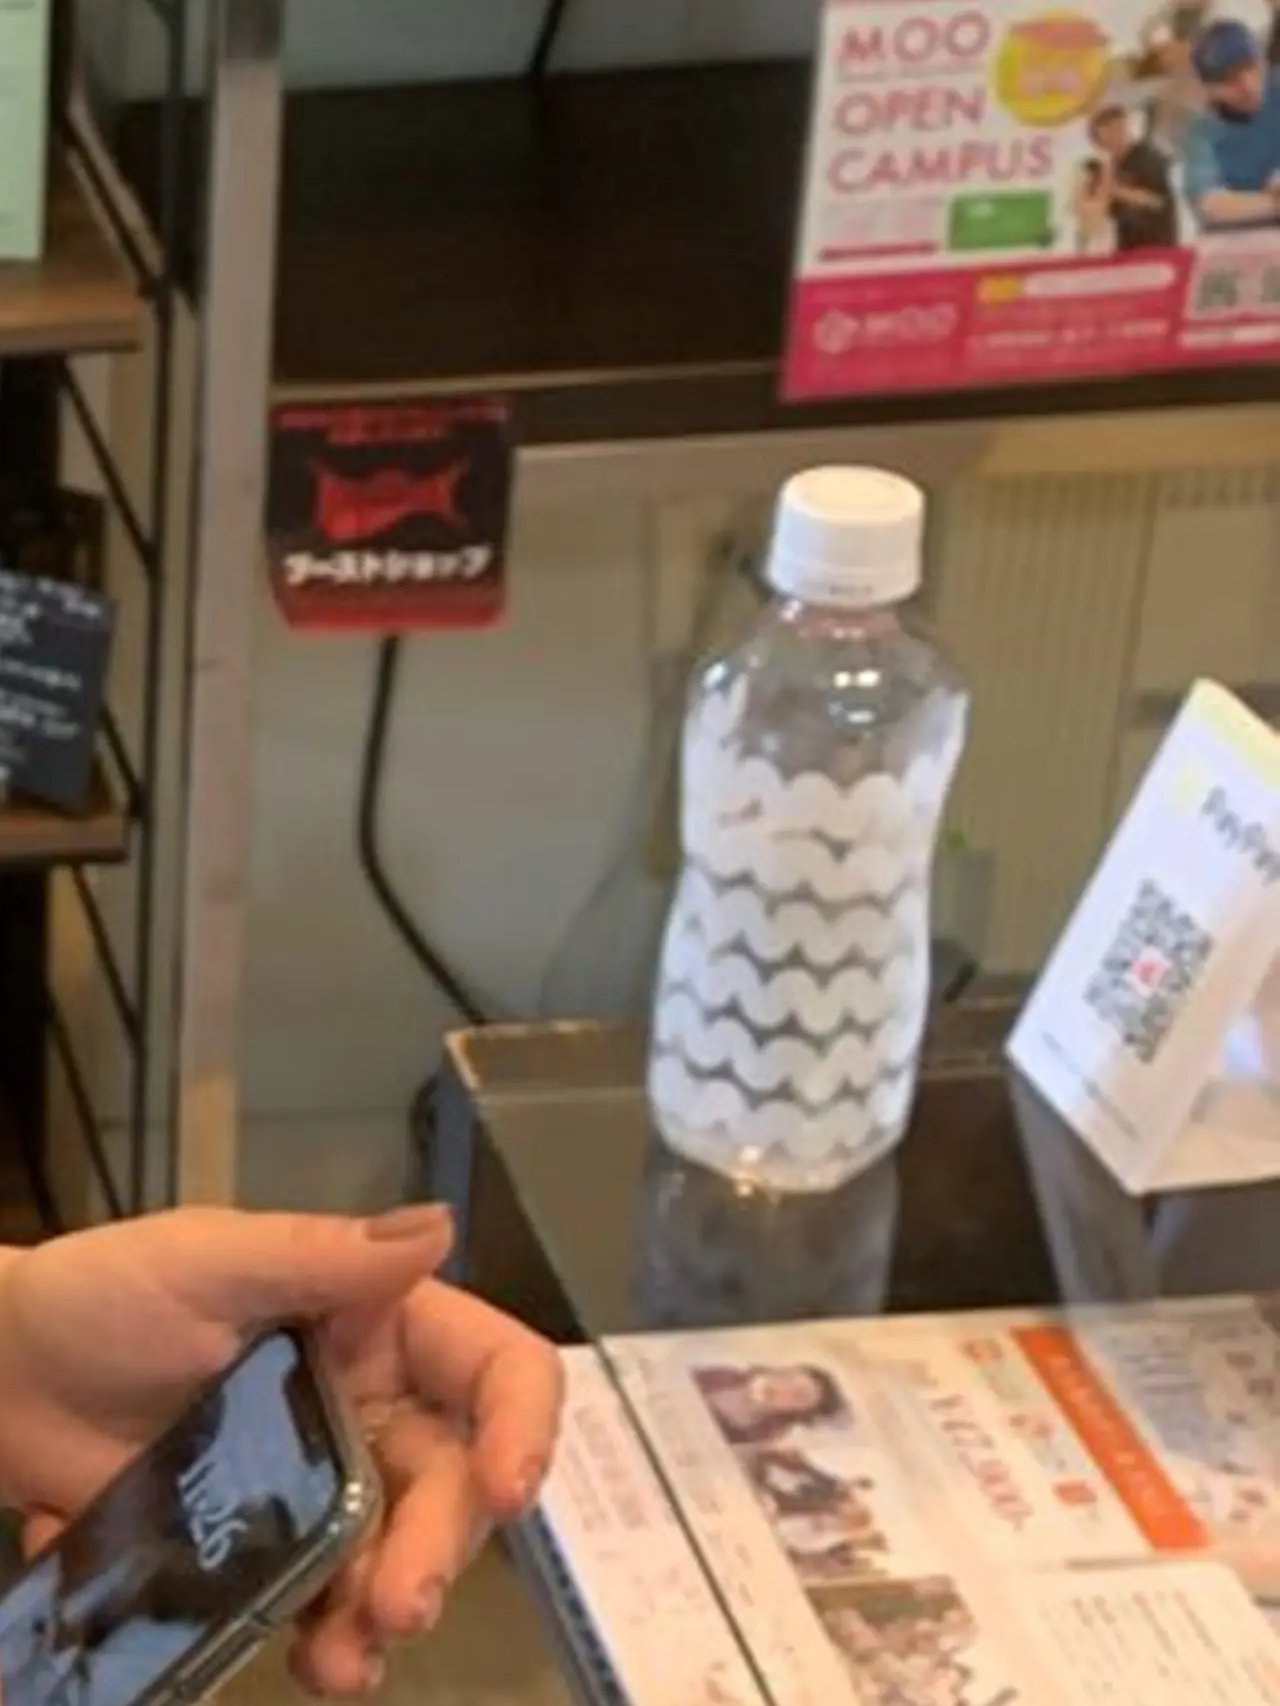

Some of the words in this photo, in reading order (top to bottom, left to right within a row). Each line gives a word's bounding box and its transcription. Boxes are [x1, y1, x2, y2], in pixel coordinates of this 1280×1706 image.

[840, 10, 990, 62] MOO
[834, 86, 986, 136] OPEN
[828, 135, 1051, 191] CAMPUS
